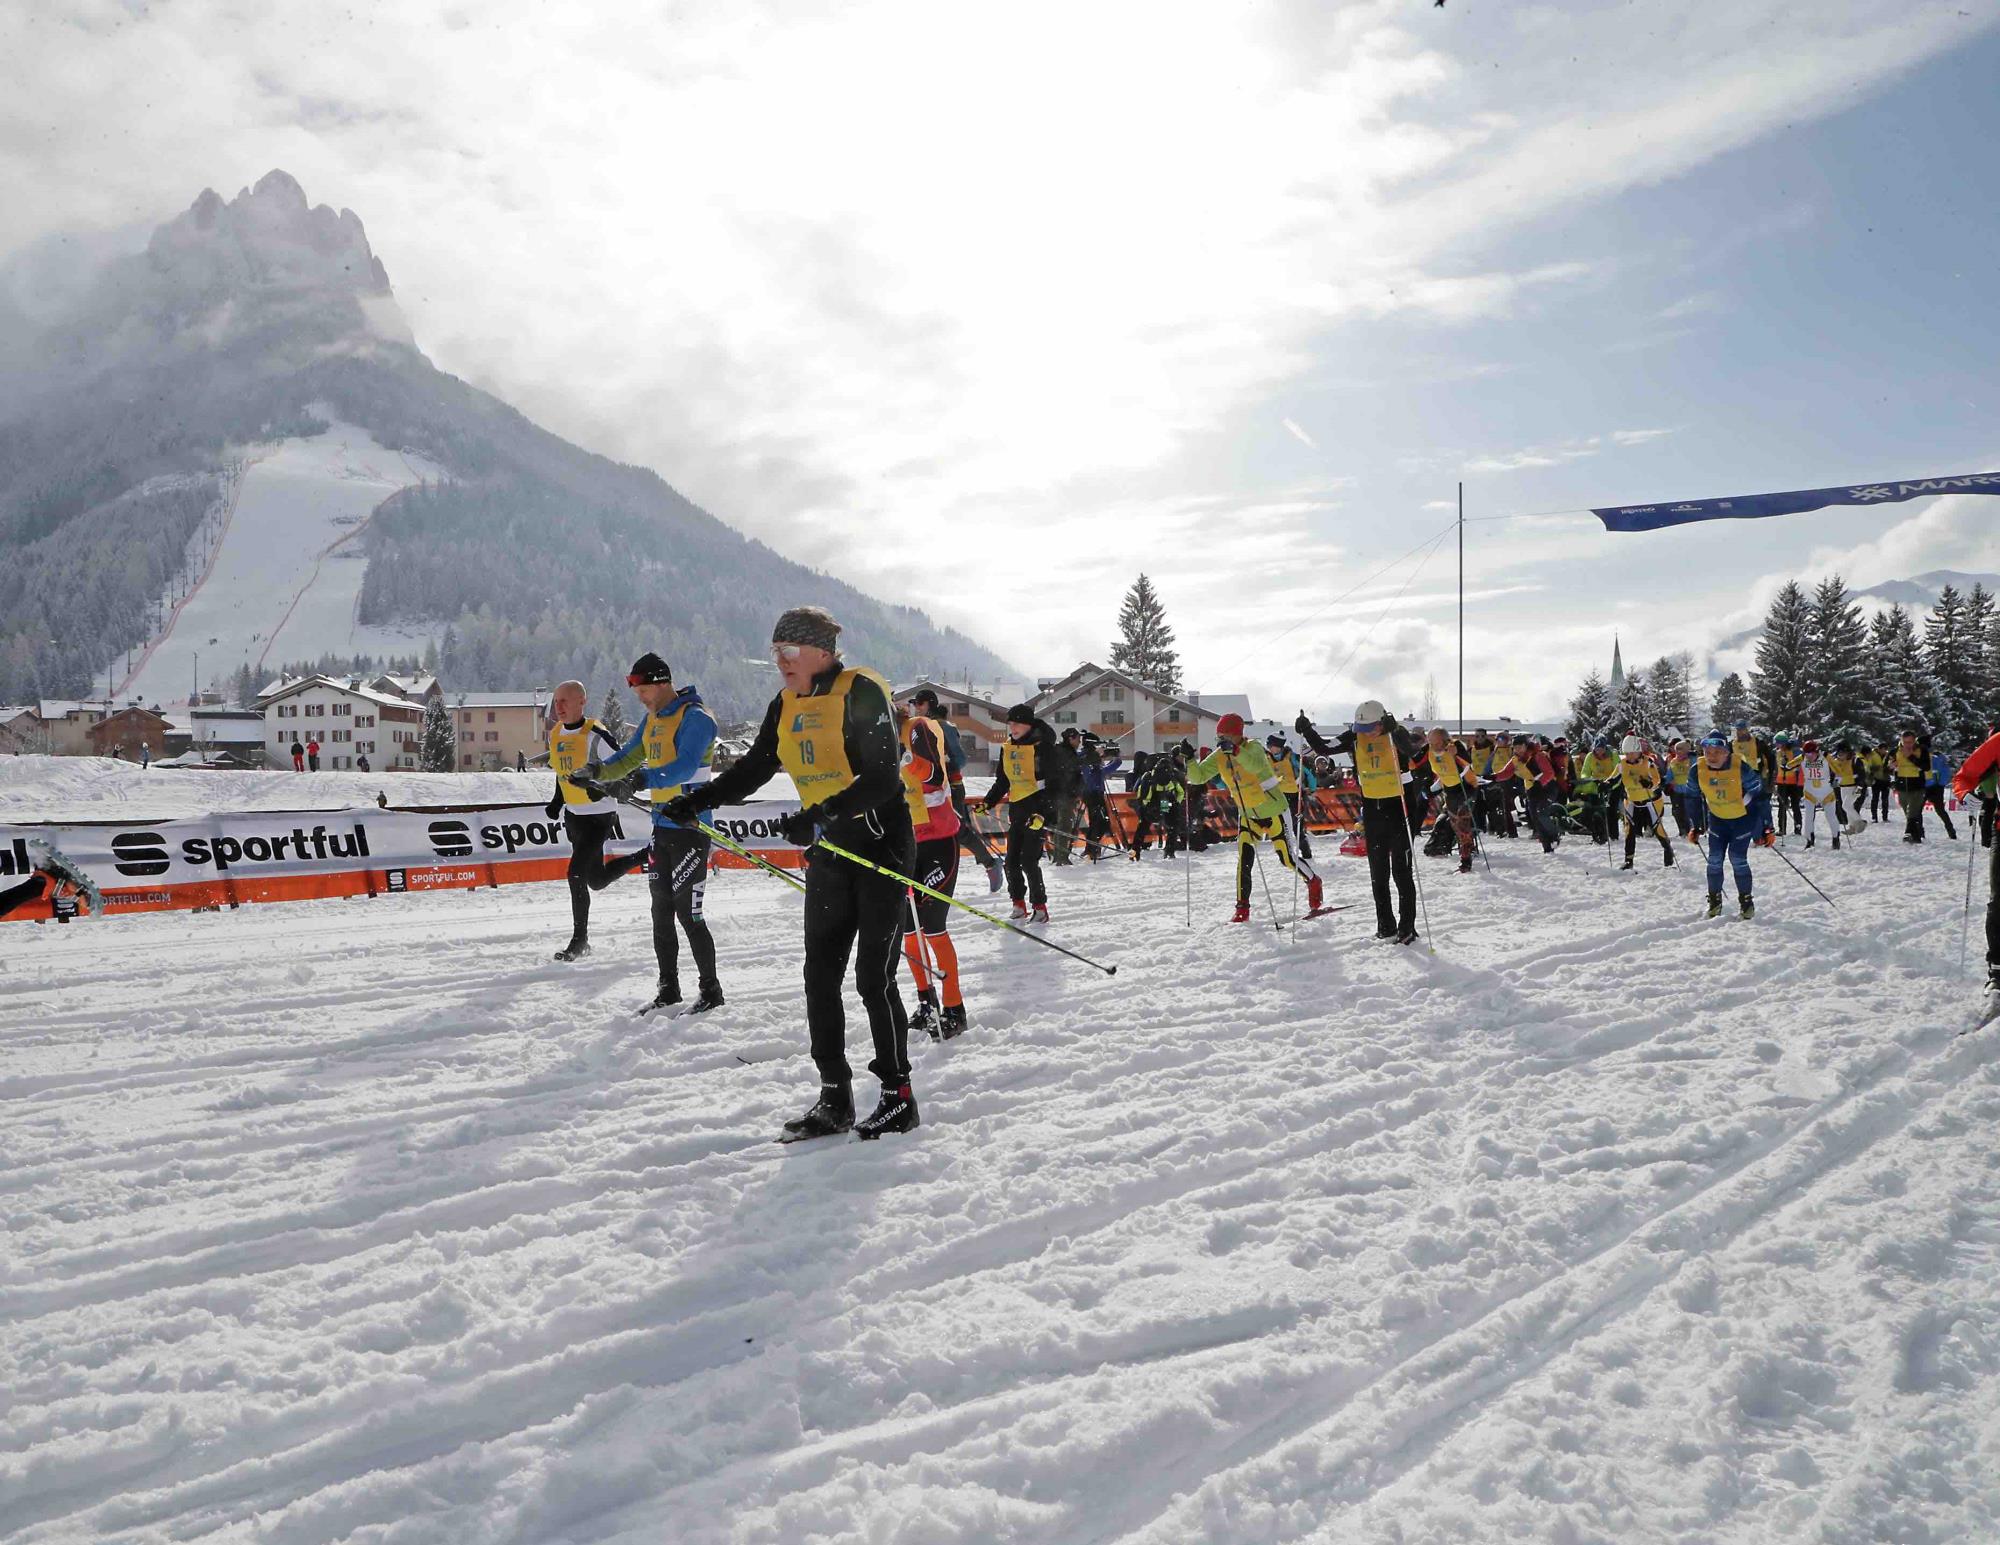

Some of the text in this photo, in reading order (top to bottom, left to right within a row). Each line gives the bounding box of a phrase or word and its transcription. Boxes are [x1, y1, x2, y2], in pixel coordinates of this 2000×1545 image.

[800, 740, 815, 765] 19
[182, 824, 370, 870] sportful
[675, 847, 697, 873] sportful
[411, 871, 476, 884] SPORTFUL.COM
[869, 1102, 908, 1130] MADSHUS
